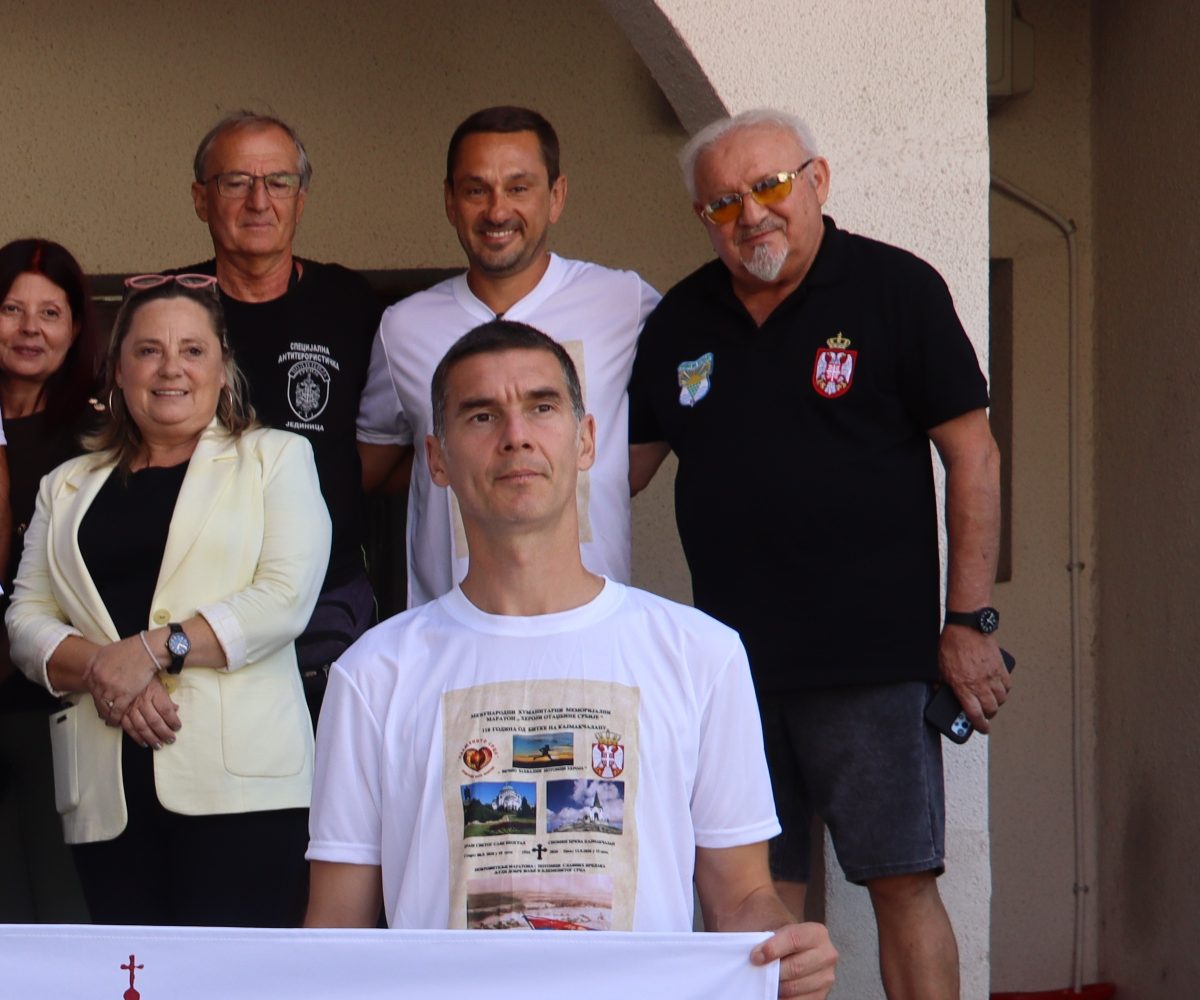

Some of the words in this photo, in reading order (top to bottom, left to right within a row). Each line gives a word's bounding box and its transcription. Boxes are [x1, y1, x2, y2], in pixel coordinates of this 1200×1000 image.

[290, 342, 330, 356] СПЕЦИЈАЛНА
[278, 352, 340, 371] АНТИТЕРОРИСТИЧКА
[285, 421, 325, 432] ЈЕДИНИЦА
